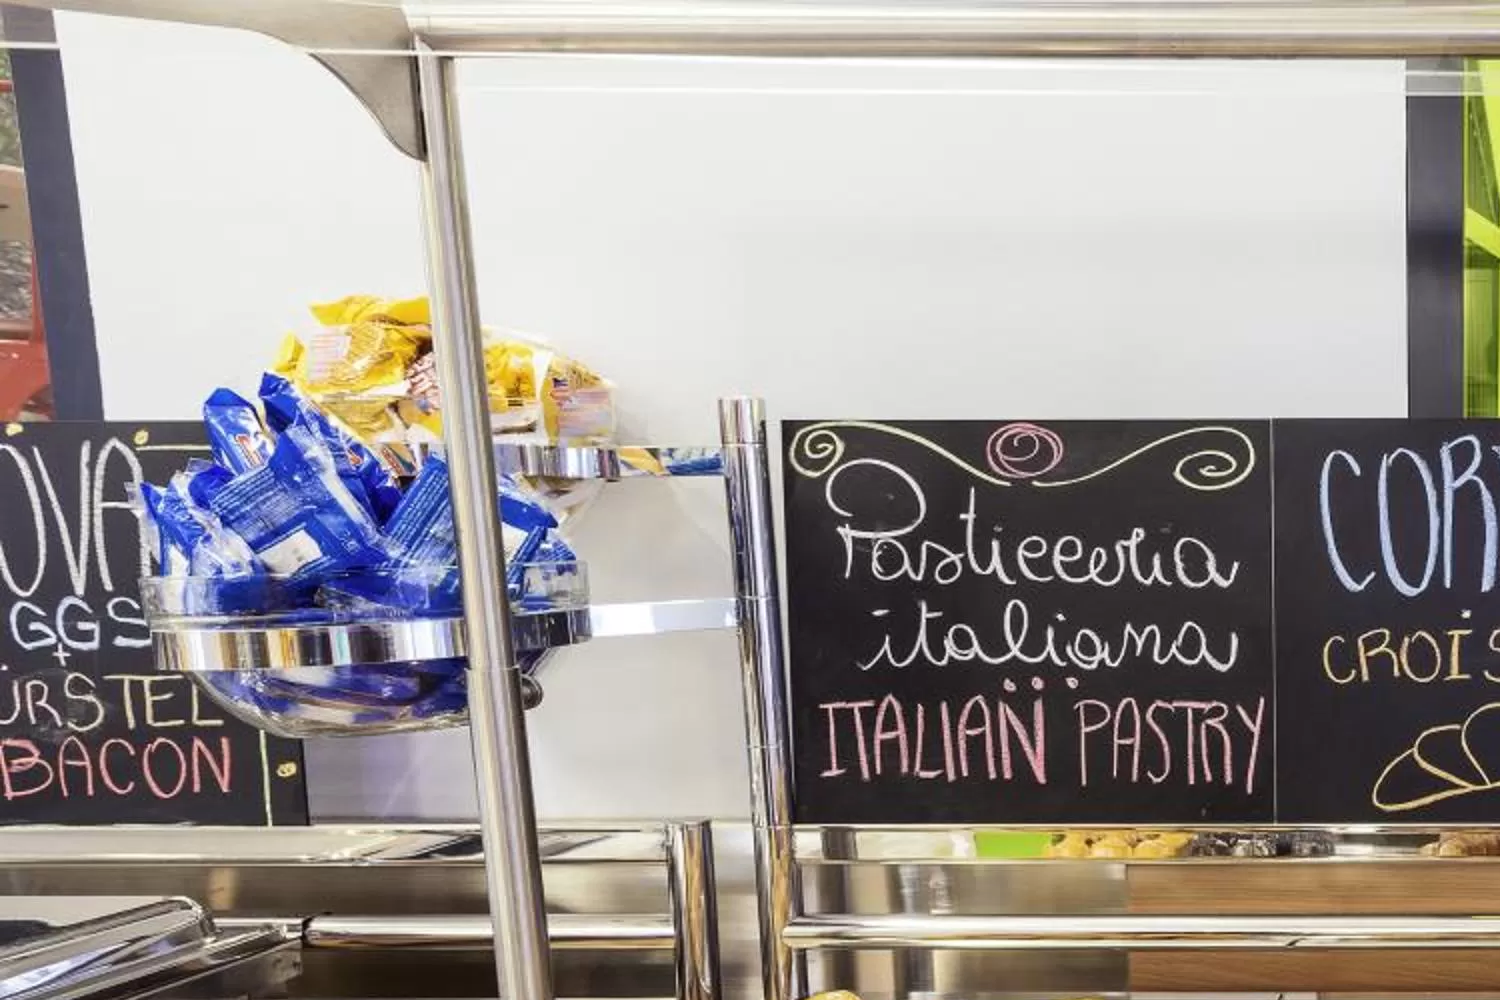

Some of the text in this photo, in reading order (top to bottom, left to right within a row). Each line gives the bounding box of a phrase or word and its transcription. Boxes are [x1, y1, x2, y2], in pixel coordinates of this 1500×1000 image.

[857, 599, 1238, 671] italiana
[0, 736, 231, 800] BACON
[818, 693, 1265, 795] ITALIAN PASTRY
